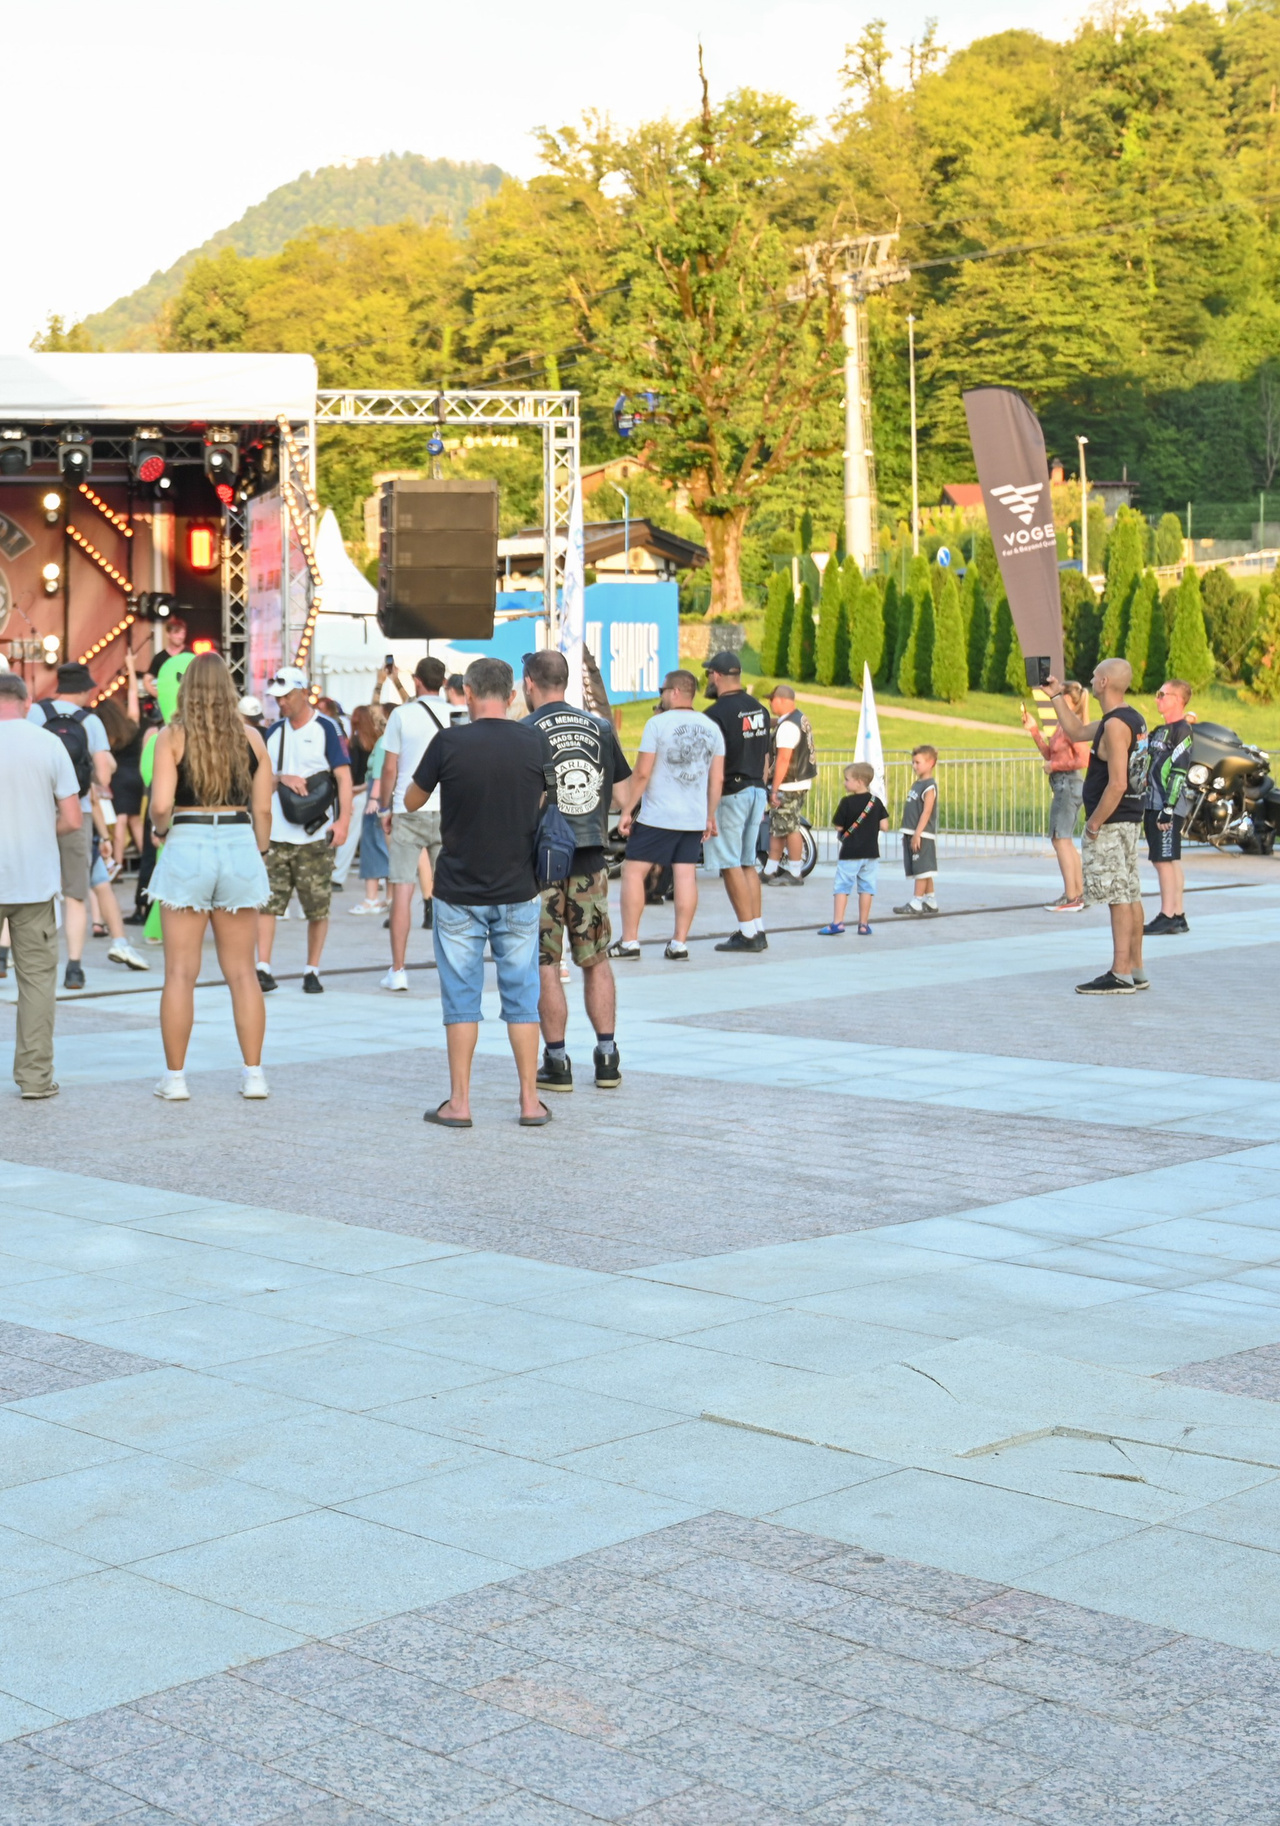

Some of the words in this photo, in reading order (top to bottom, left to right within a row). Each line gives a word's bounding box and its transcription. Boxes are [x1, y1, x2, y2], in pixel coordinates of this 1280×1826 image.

[1003, 523, 1056, 547] VOGE
[539, 718, 553, 730] IFE
[555, 715, 590, 727] MEMBER
[557, 741, 581, 750] RUSSIA
[574, 734, 595, 747] CREW
[559, 760, 594, 773] ARLEY
[558, 802, 583, 813] WNERS
[1162, 828, 1173, 858] RUSS
